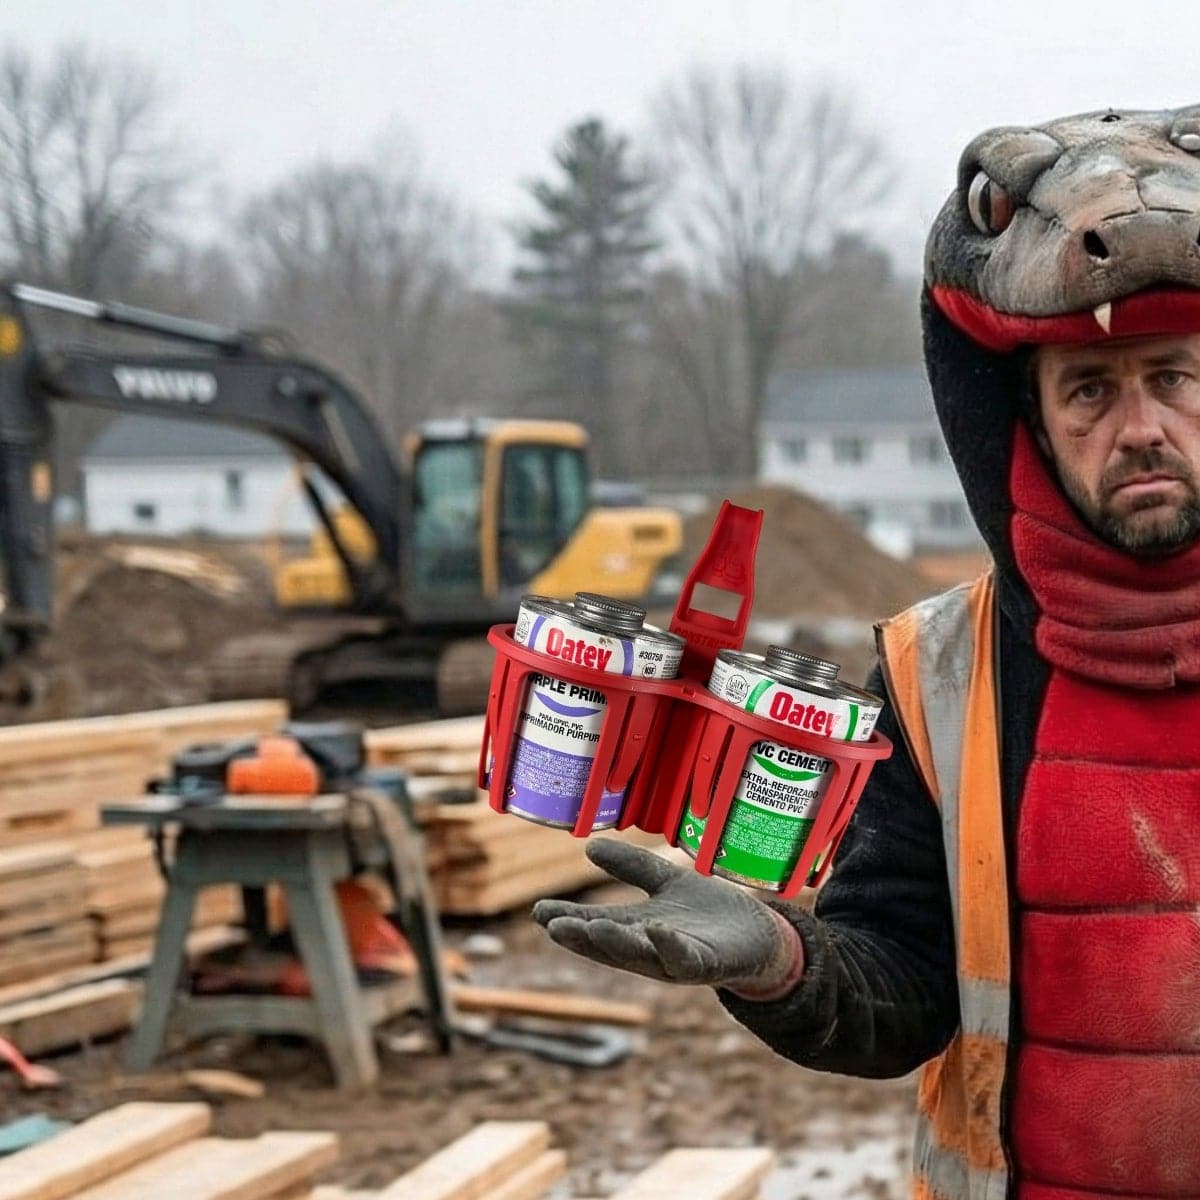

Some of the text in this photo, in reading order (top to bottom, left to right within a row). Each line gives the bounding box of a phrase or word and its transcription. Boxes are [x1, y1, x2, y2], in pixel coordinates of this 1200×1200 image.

[546, 627, 612, 672] Oatey
[569, 685, 608, 705] PRIM
[566, 729, 600, 742] PURPUR
[755, 743, 832, 772] VC CEMENT
[743, 770, 818, 798] EXTRA-REFORZADO
[746, 781, 810, 806] TRANSPARENTE
[746, 791, 804, 813] CEMENTO PVC
